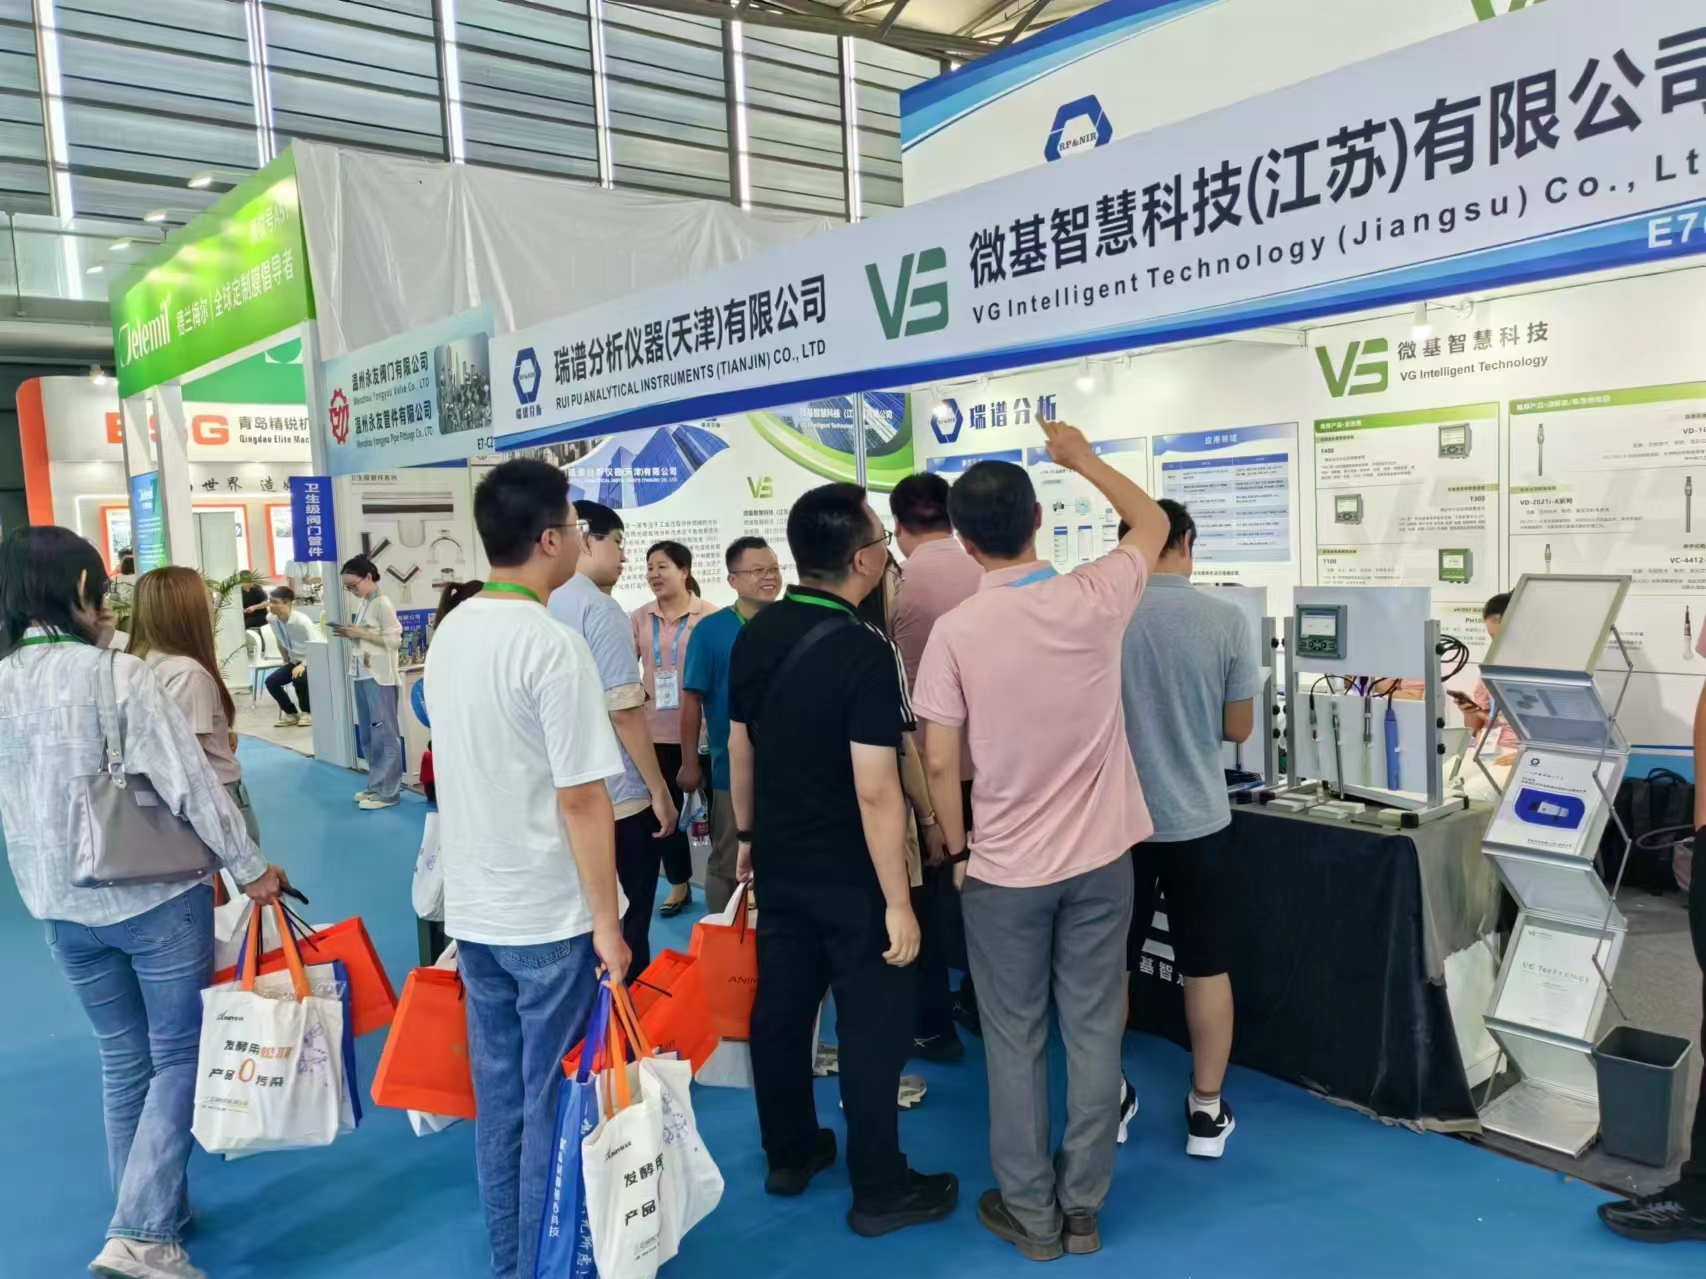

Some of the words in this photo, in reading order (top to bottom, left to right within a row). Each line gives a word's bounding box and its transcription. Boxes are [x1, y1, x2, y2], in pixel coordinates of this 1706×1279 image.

[970, 27, 1706, 288] 微基智慧科技(江苏)有限公司
[1058, 132, 1098, 152] RP&NIR
[973, 302, 1001, 324] VG
[1008, 273, 1138, 317] Intelligent
[1147, 234, 1325, 289] Technology
[1337, 185, 1527, 255] (Jiangsu)
[1544, 176, 1636, 204] Co.,
[553, 274, 827, 386] 瑞谱分析仪器(天津)有限公司
[1398, 321, 1549, 361] 微基智慧科技
[555, 394, 570, 410] RUI
[571, 391, 583, 406] PU
[584, 381, 640, 404] ANALYTICAL
[640, 364, 714, 393] INSTRUMENTS
[716, 352, 771, 380] (TIANJIN)
[773, 346, 801, 365] CO.,
[801, 339, 827, 359] LTD
[1400, 368, 1416, 381] VG
[1420, 364, 1475, 380] Intelligent
[1479, 354, 1548, 373] Technology
[239, 434, 273, 445] Qingdao
[274, 434, 292, 444] Elite
